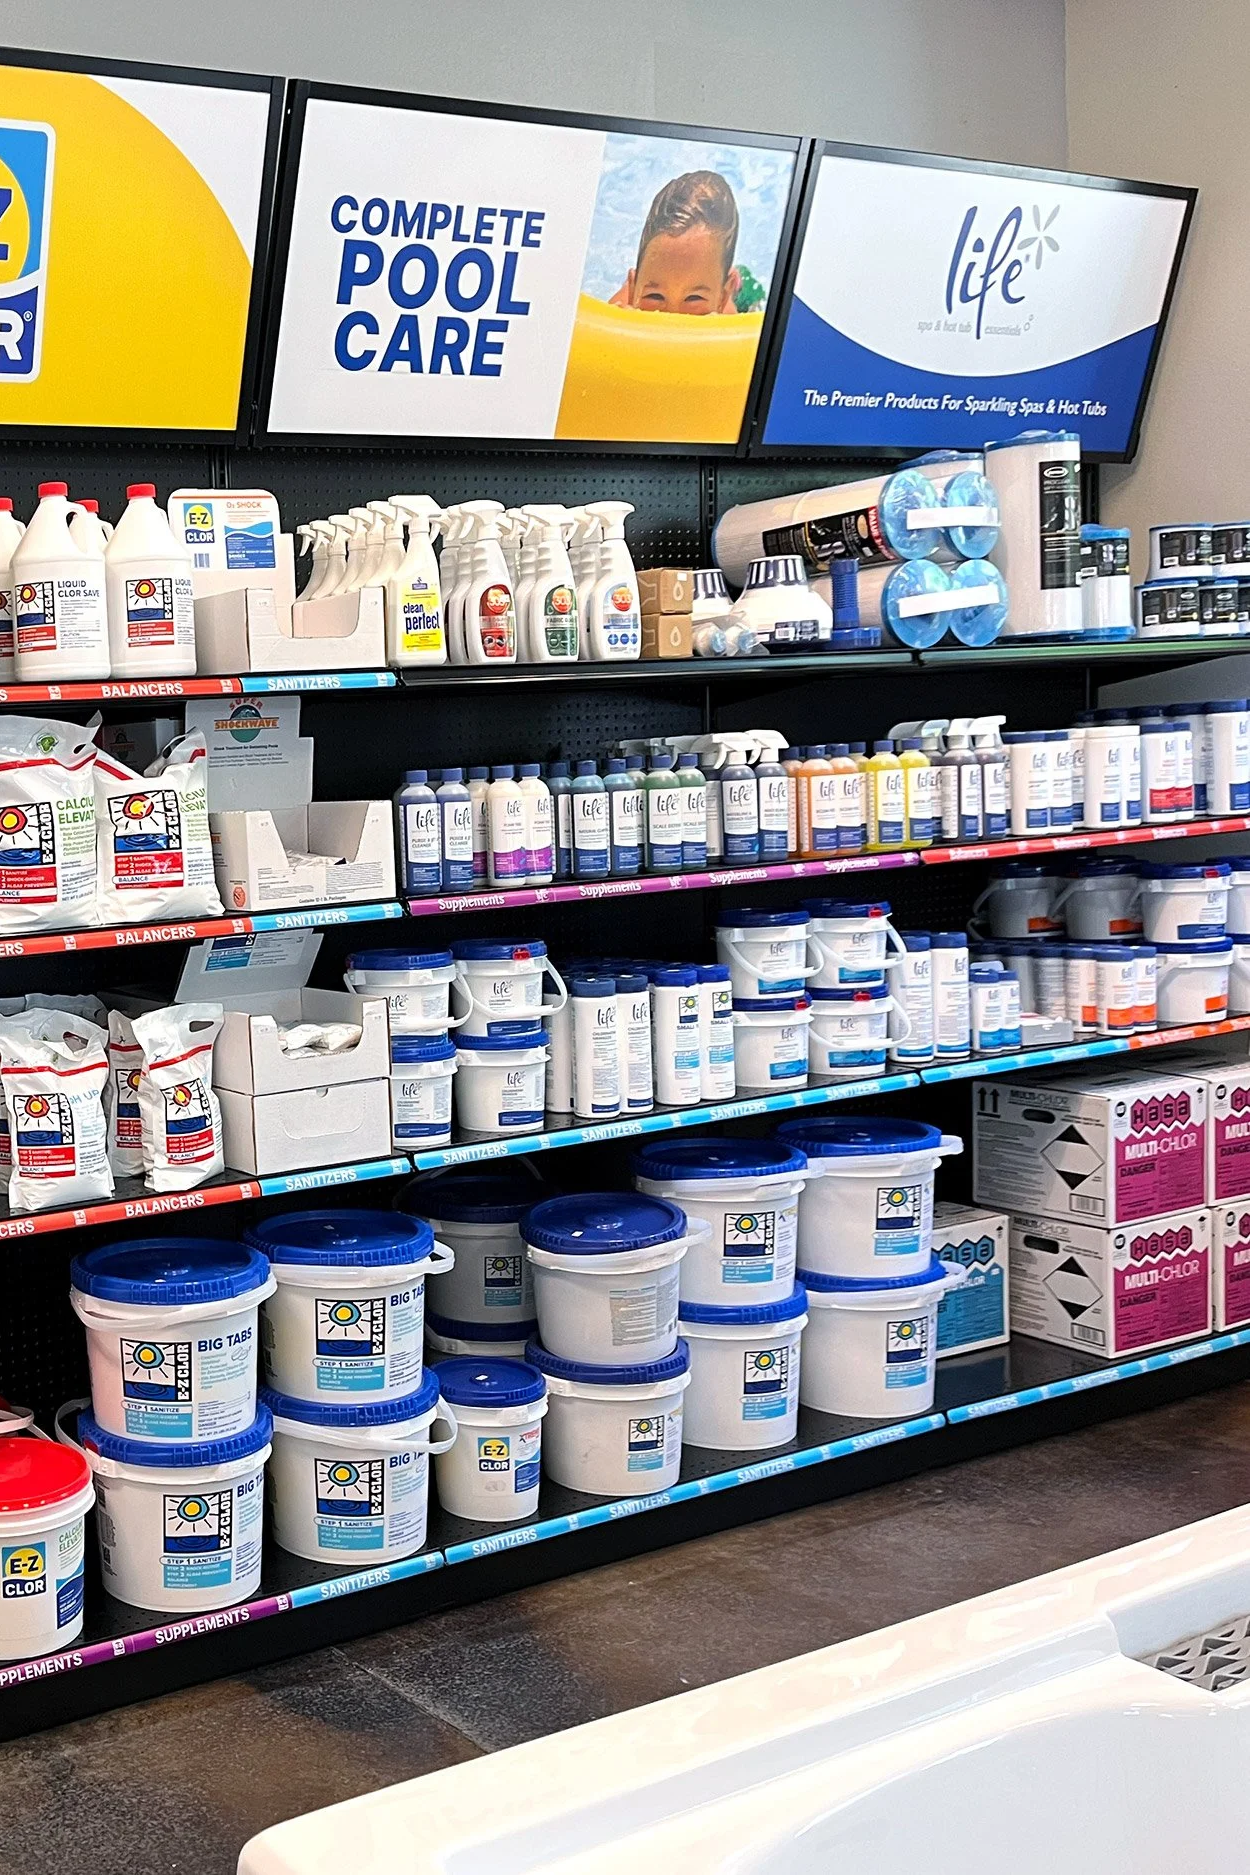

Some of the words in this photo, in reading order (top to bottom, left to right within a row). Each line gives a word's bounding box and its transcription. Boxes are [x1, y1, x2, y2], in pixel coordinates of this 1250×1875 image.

[331, 195, 545, 248] COMPLETE
[336, 239, 531, 315] POOL
[946, 206, 1025, 339] life
[917, 320, 932, 333] spa
[334, 311, 509, 376] CARE
[804, 389, 827, 406] The
[831, 391, 881, 408] Premier
[884, 392, 938, 411] Products
[941, 395, 961, 411] For
[964, 396, 1016, 416] Sparkling
[1020, 399, 1043, 416] Spas
[1046, 400, 1055, 414] &
[1057, 400, 1079, 415] Hot
[1082, 401, 1107, 416] Tubs
[236, 501, 262, 509] SHOCK
[189, 512, 209, 525] E-Z
[186, 532, 215, 543] CLOR
[57, 580, 87, 588] LIQUID
[57, 588, 82, 598] CLOR
[403, 603, 424, 615] clean
[405, 611, 441, 633] perfect
[102, 683, 184, 698] BALANCERS
[268, 676, 341, 690] SANITIZERS
[229, 697, 264, 711] SUPER
[213, 718, 279, 730] SHOCKWAVE
[729, 783, 750, 806] life
[582, 797, 603, 820] life
[710, 868, 768, 885] Supplements
[579, 879, 642, 898] Supplements
[438, 893, 505, 911] Supplements
[275, 910, 349, 928] SANITIZERS
[116, 926, 196, 945] BALANCERS
[402, 1083, 419, 1099] life
[710, 1102, 768, 1120] SANITIZERS
[581, 1123, 643, 1142] SANITIZERS
[443, 1143, 509, 1164] SANITIZERS
[1125, 1132, 1197, 1161] MULTI-CHLOR
[285, 1168, 358, 1191] SANITIZERS
[1120, 1162, 1156, 1178] DANGER
[125, 1193, 205, 1217] BALANCERS
[198, 1337, 224, 1352] BIG
[227, 1327, 252, 1347] TABS
[853, 1426, 908, 1451] SANITIZERS
[737, 1458, 795, 1484] SANITIZERS
[609, 1491, 672, 1519] SANITIZERS
[472, 1527, 538, 1556] SANITIZERS
[9, 1555, 40, 1574] E-Z
[4, 1580, 46, 1596] CLOR
[320, 1567, 391, 1599] SANITIZERS
[154, 1606, 250, 1645] SUPPLEMENTS
